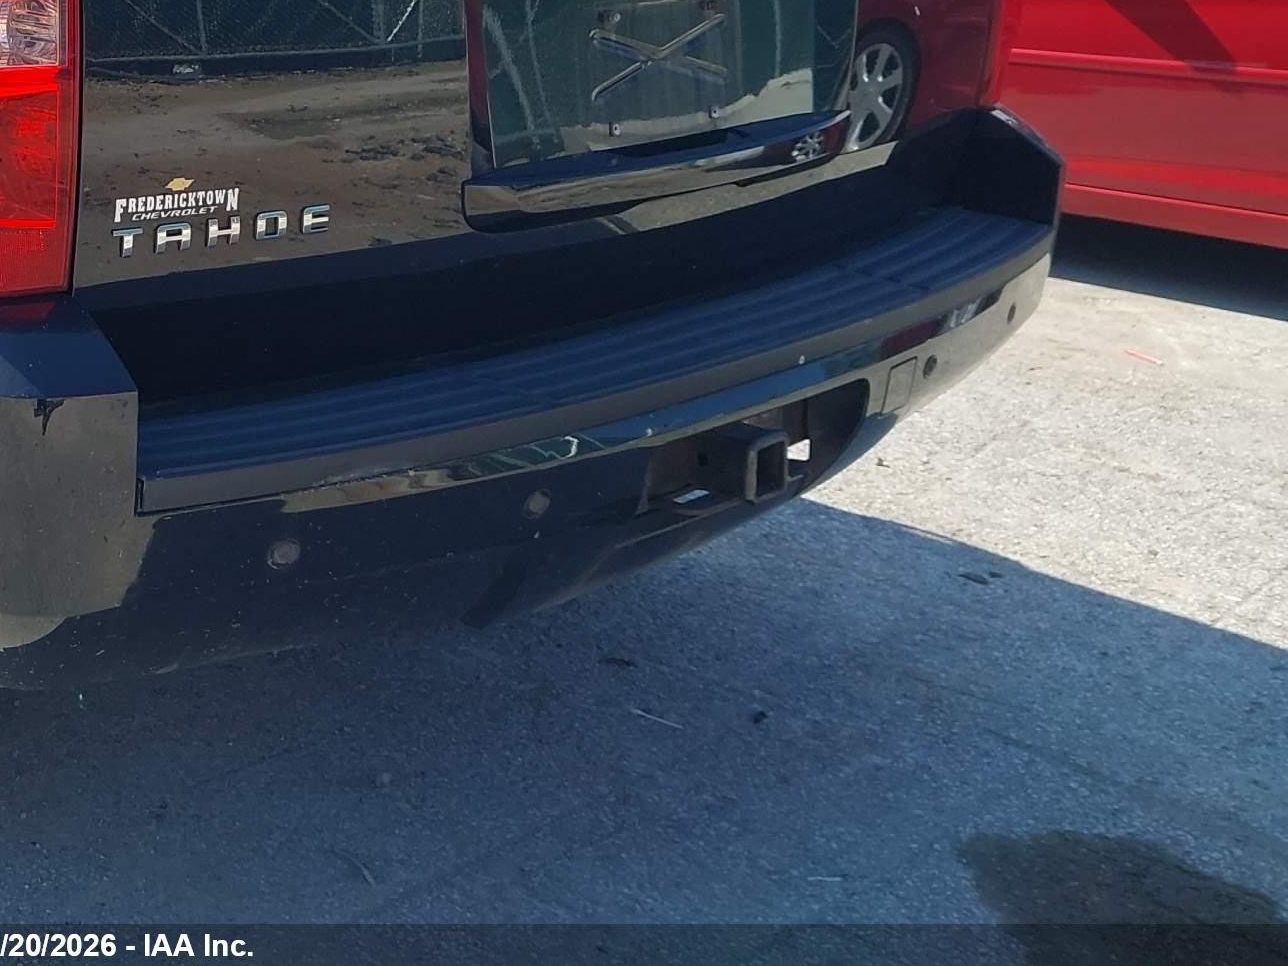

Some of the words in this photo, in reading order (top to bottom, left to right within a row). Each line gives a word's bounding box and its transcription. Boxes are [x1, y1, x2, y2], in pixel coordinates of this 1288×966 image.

[113, 187, 241, 224] FREDERICKTOWN
[131, 204, 219, 222] CHEVROLET
[112, 204, 331, 258] TAHOE
